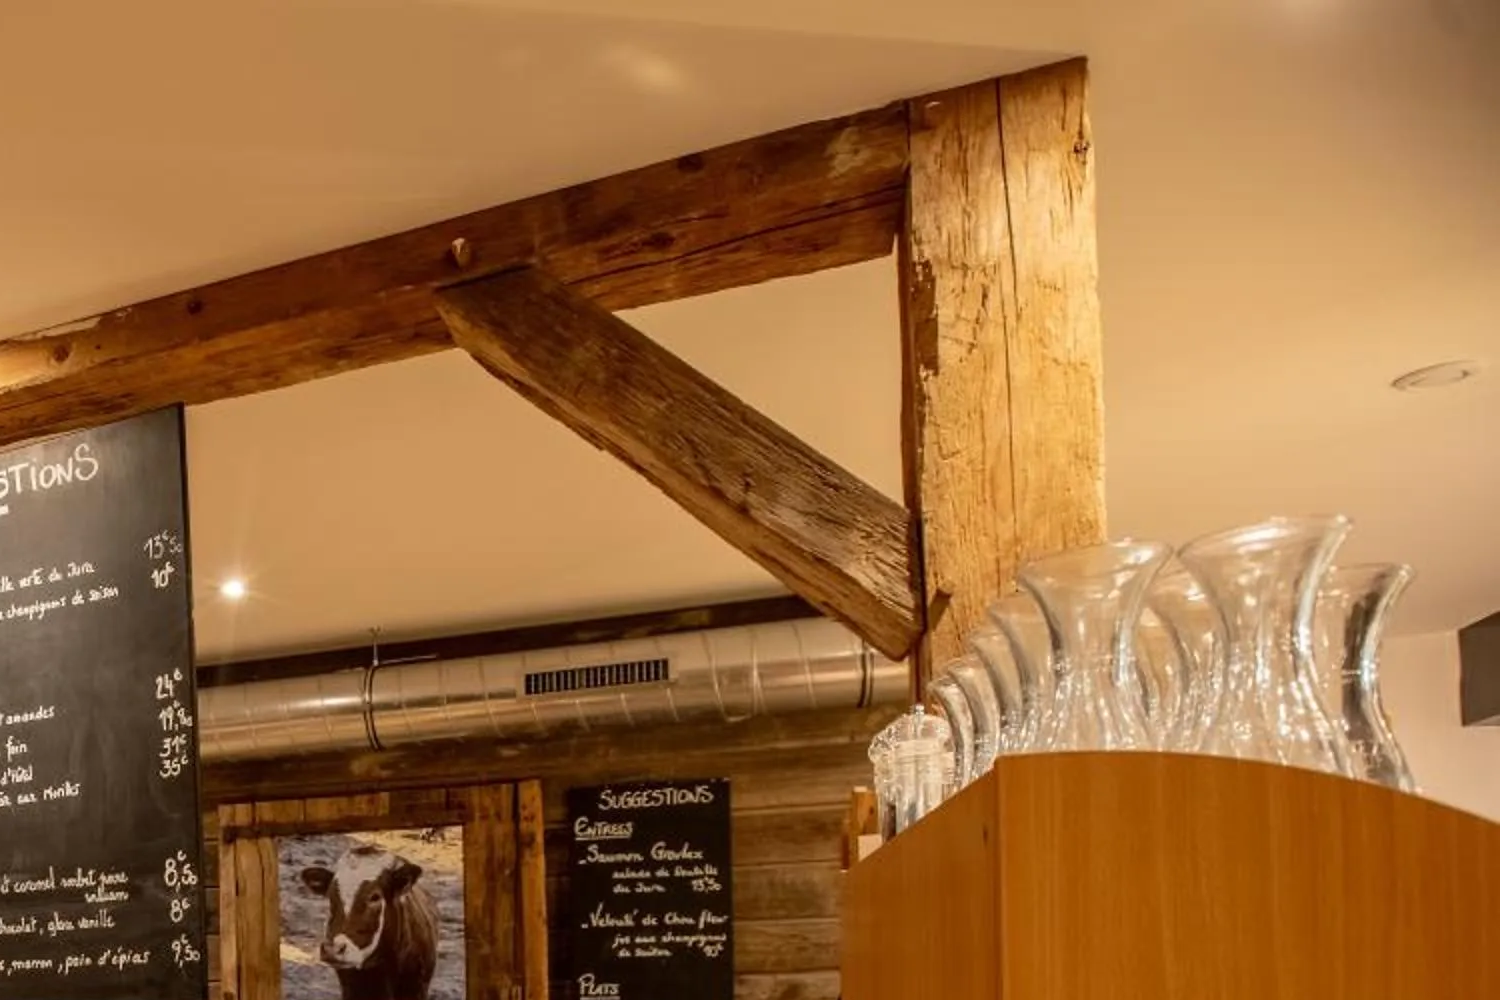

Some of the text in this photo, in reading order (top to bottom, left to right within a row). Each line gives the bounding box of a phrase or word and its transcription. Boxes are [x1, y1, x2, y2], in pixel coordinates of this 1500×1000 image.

[67, 561, 96, 578] Jura
[71, 589, 85, 606] de
[597, 784, 714, 811] SUGGESTIONS
